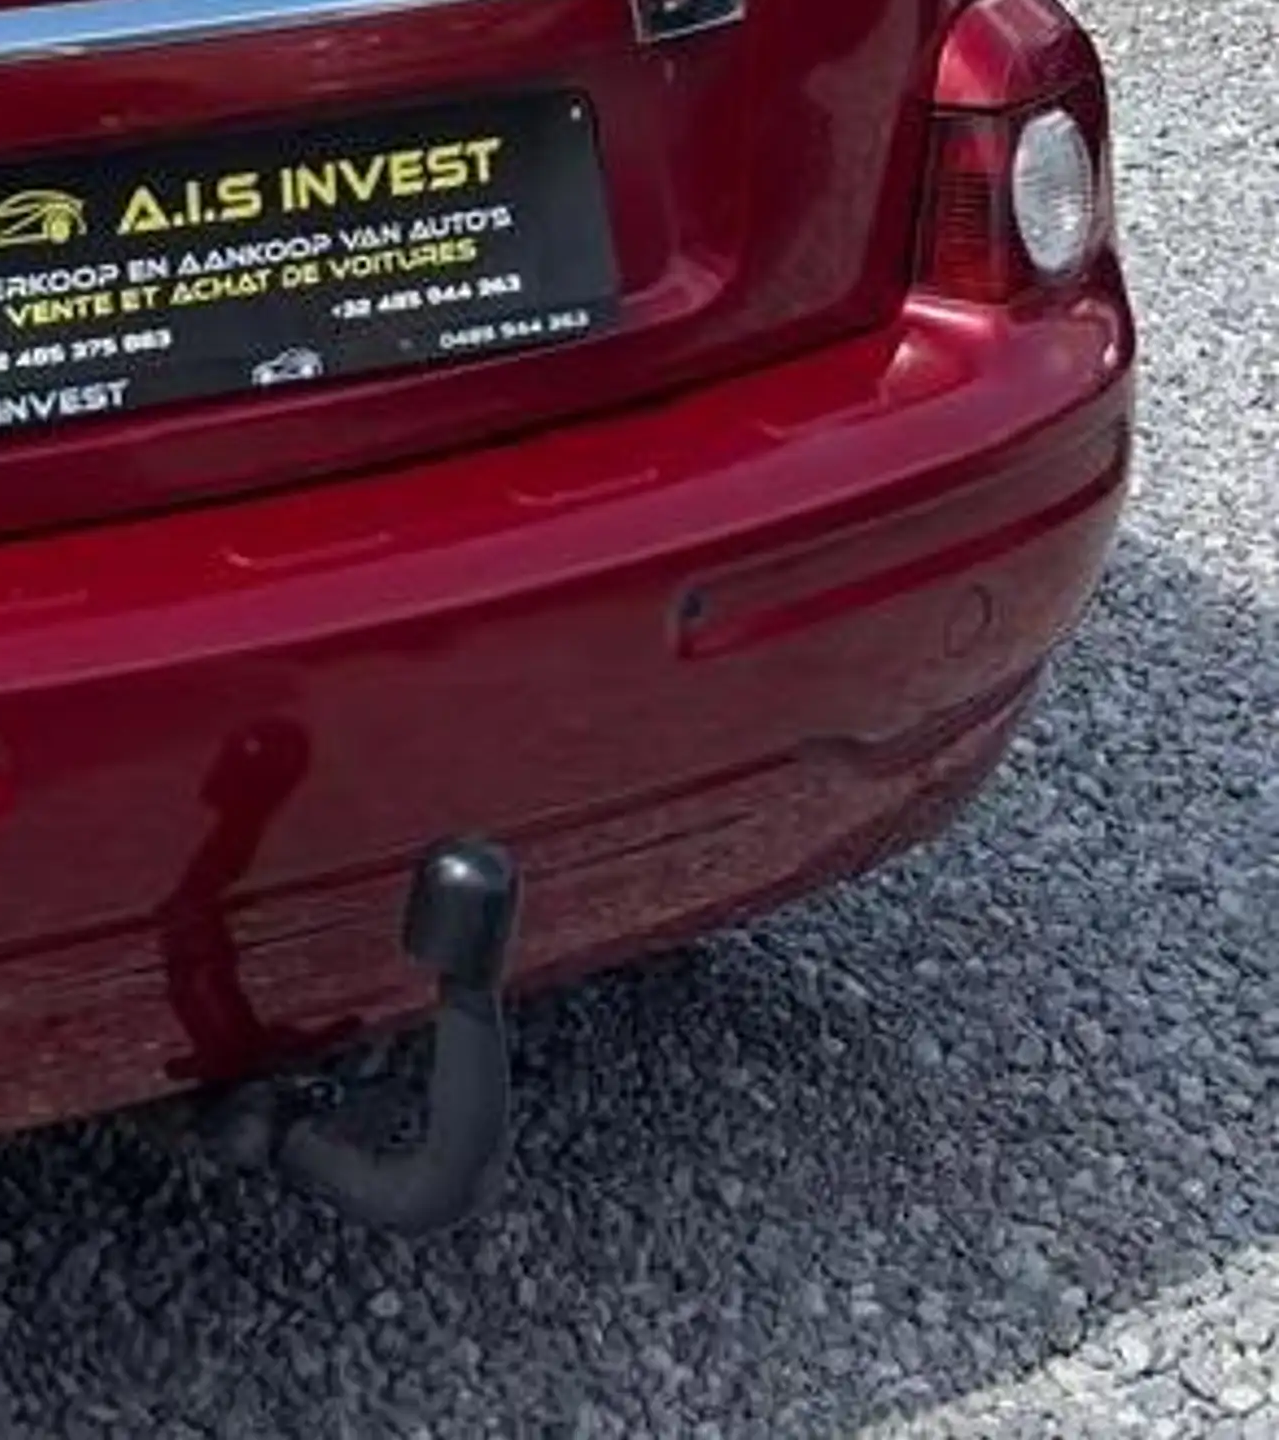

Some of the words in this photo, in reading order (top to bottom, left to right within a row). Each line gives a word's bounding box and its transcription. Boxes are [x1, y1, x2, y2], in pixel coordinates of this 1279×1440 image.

[116, 171, 263, 236] A.I.S
[279, 137, 501, 212] INVEST
[5, 290, 114, 328] VENTE
[120, 285, 160, 311] ET
[170, 268, 272, 306] ACHAT
[280, 262, 320, 289] DE
[328, 237, 478, 279] VOITURES
[127, 256, 169, 284] EN
[177, 232, 332, 276] AANKOOP
[339, 221, 403, 252] VAN
